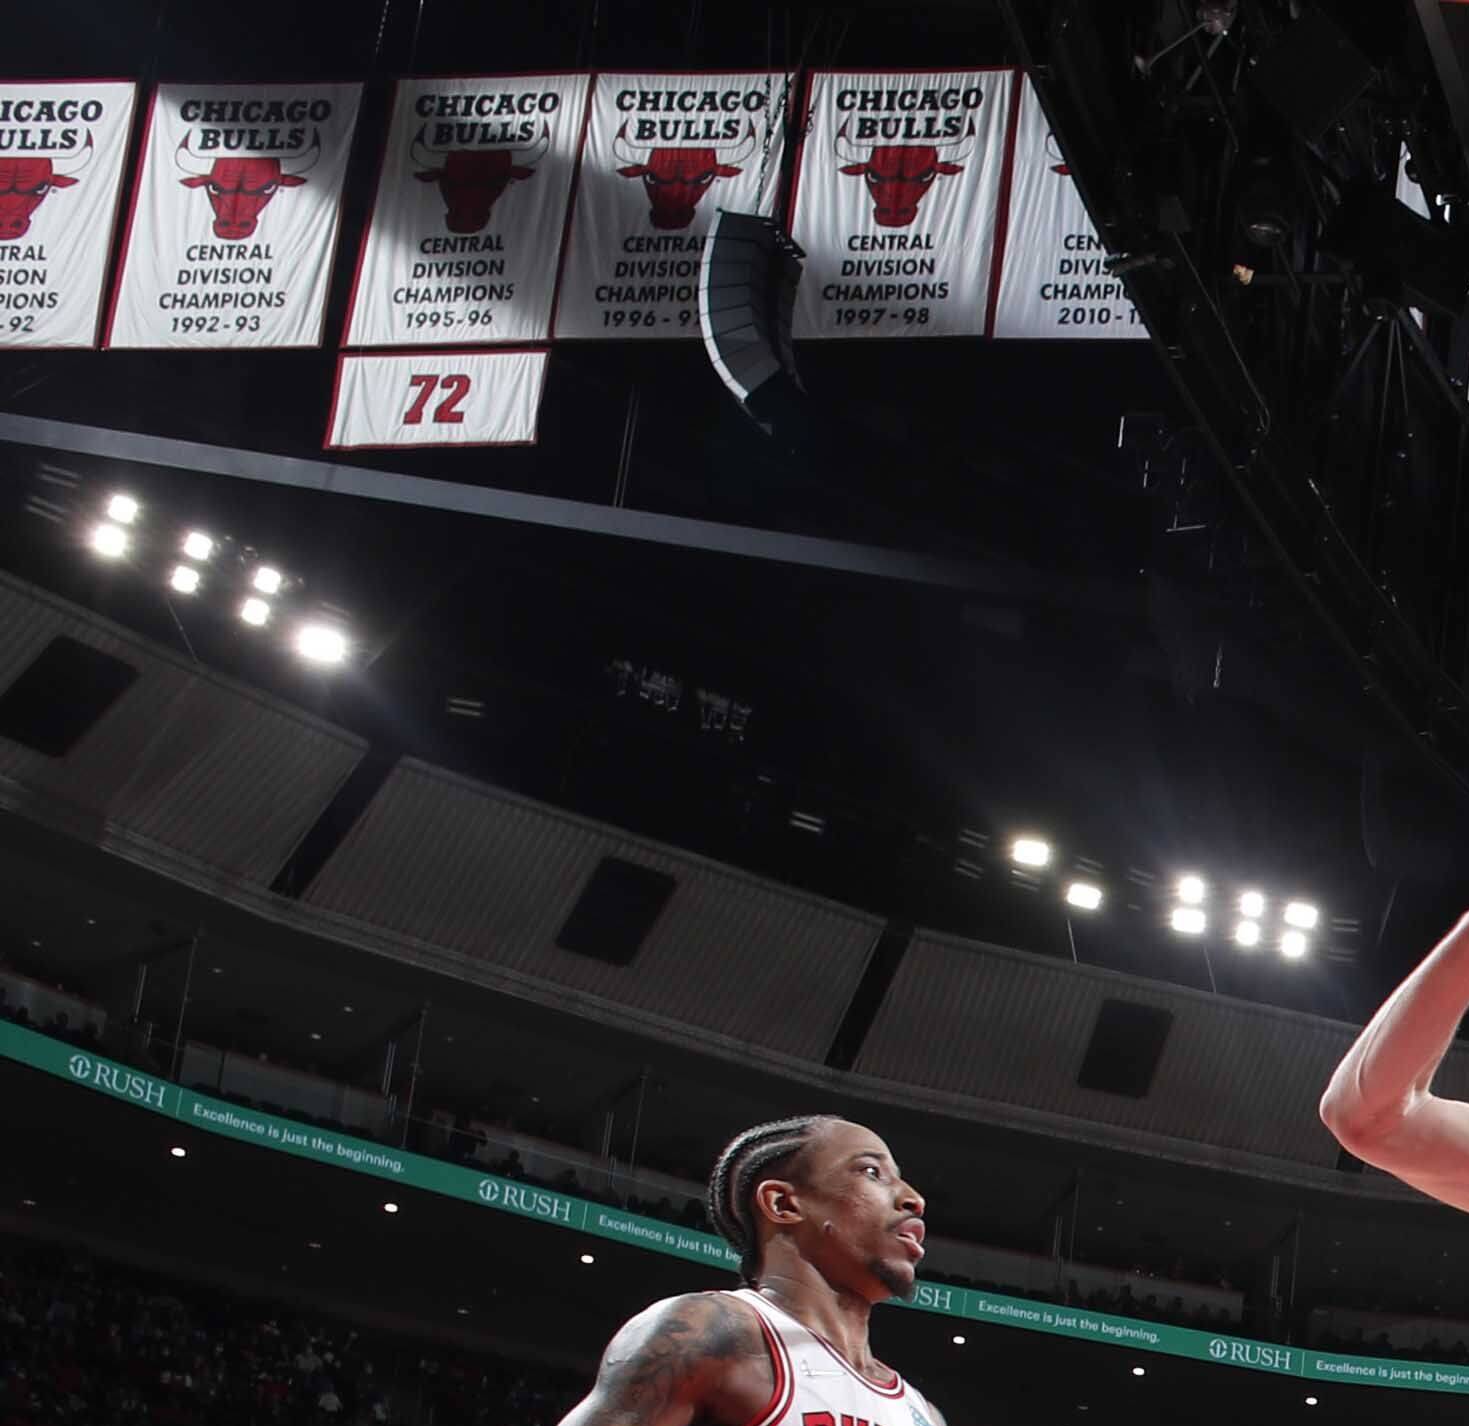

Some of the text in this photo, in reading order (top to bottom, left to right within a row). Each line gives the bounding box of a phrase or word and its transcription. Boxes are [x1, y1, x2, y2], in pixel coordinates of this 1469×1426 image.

[180, 99, 331, 122] CHICAGO
[415, 92, 559, 117] CHICAGO
[836, 88, 983, 113] CHICAGO
[199, 127, 304, 150] BULLS
[433, 120, 534, 145] BULLS
[856, 117, 962, 139] BULLS
[186, 244, 273, 261] CENTRAL
[420, 236, 505, 254] CENTRAL
[848, 234, 934, 251] CENTRAL
[177, 267, 272, 285] DIVISION
[413, 259, 505, 278] DIVISION
[841, 258, 935, 276] DIVISION
[159, 291, 286, 309] CHAMPIONS
[393, 283, 514, 303] CHAMPIONS
[822, 282, 949, 300] CHAMPIONS
[403, 374, 471, 424] 72
[94, 1063, 166, 1108] RUSH
[194, 1103, 405, 1172] Excellence is just the beginning.
[502, 1185, 572, 1222] RUSH
[1231, 1343, 1291, 1369] RUSH
